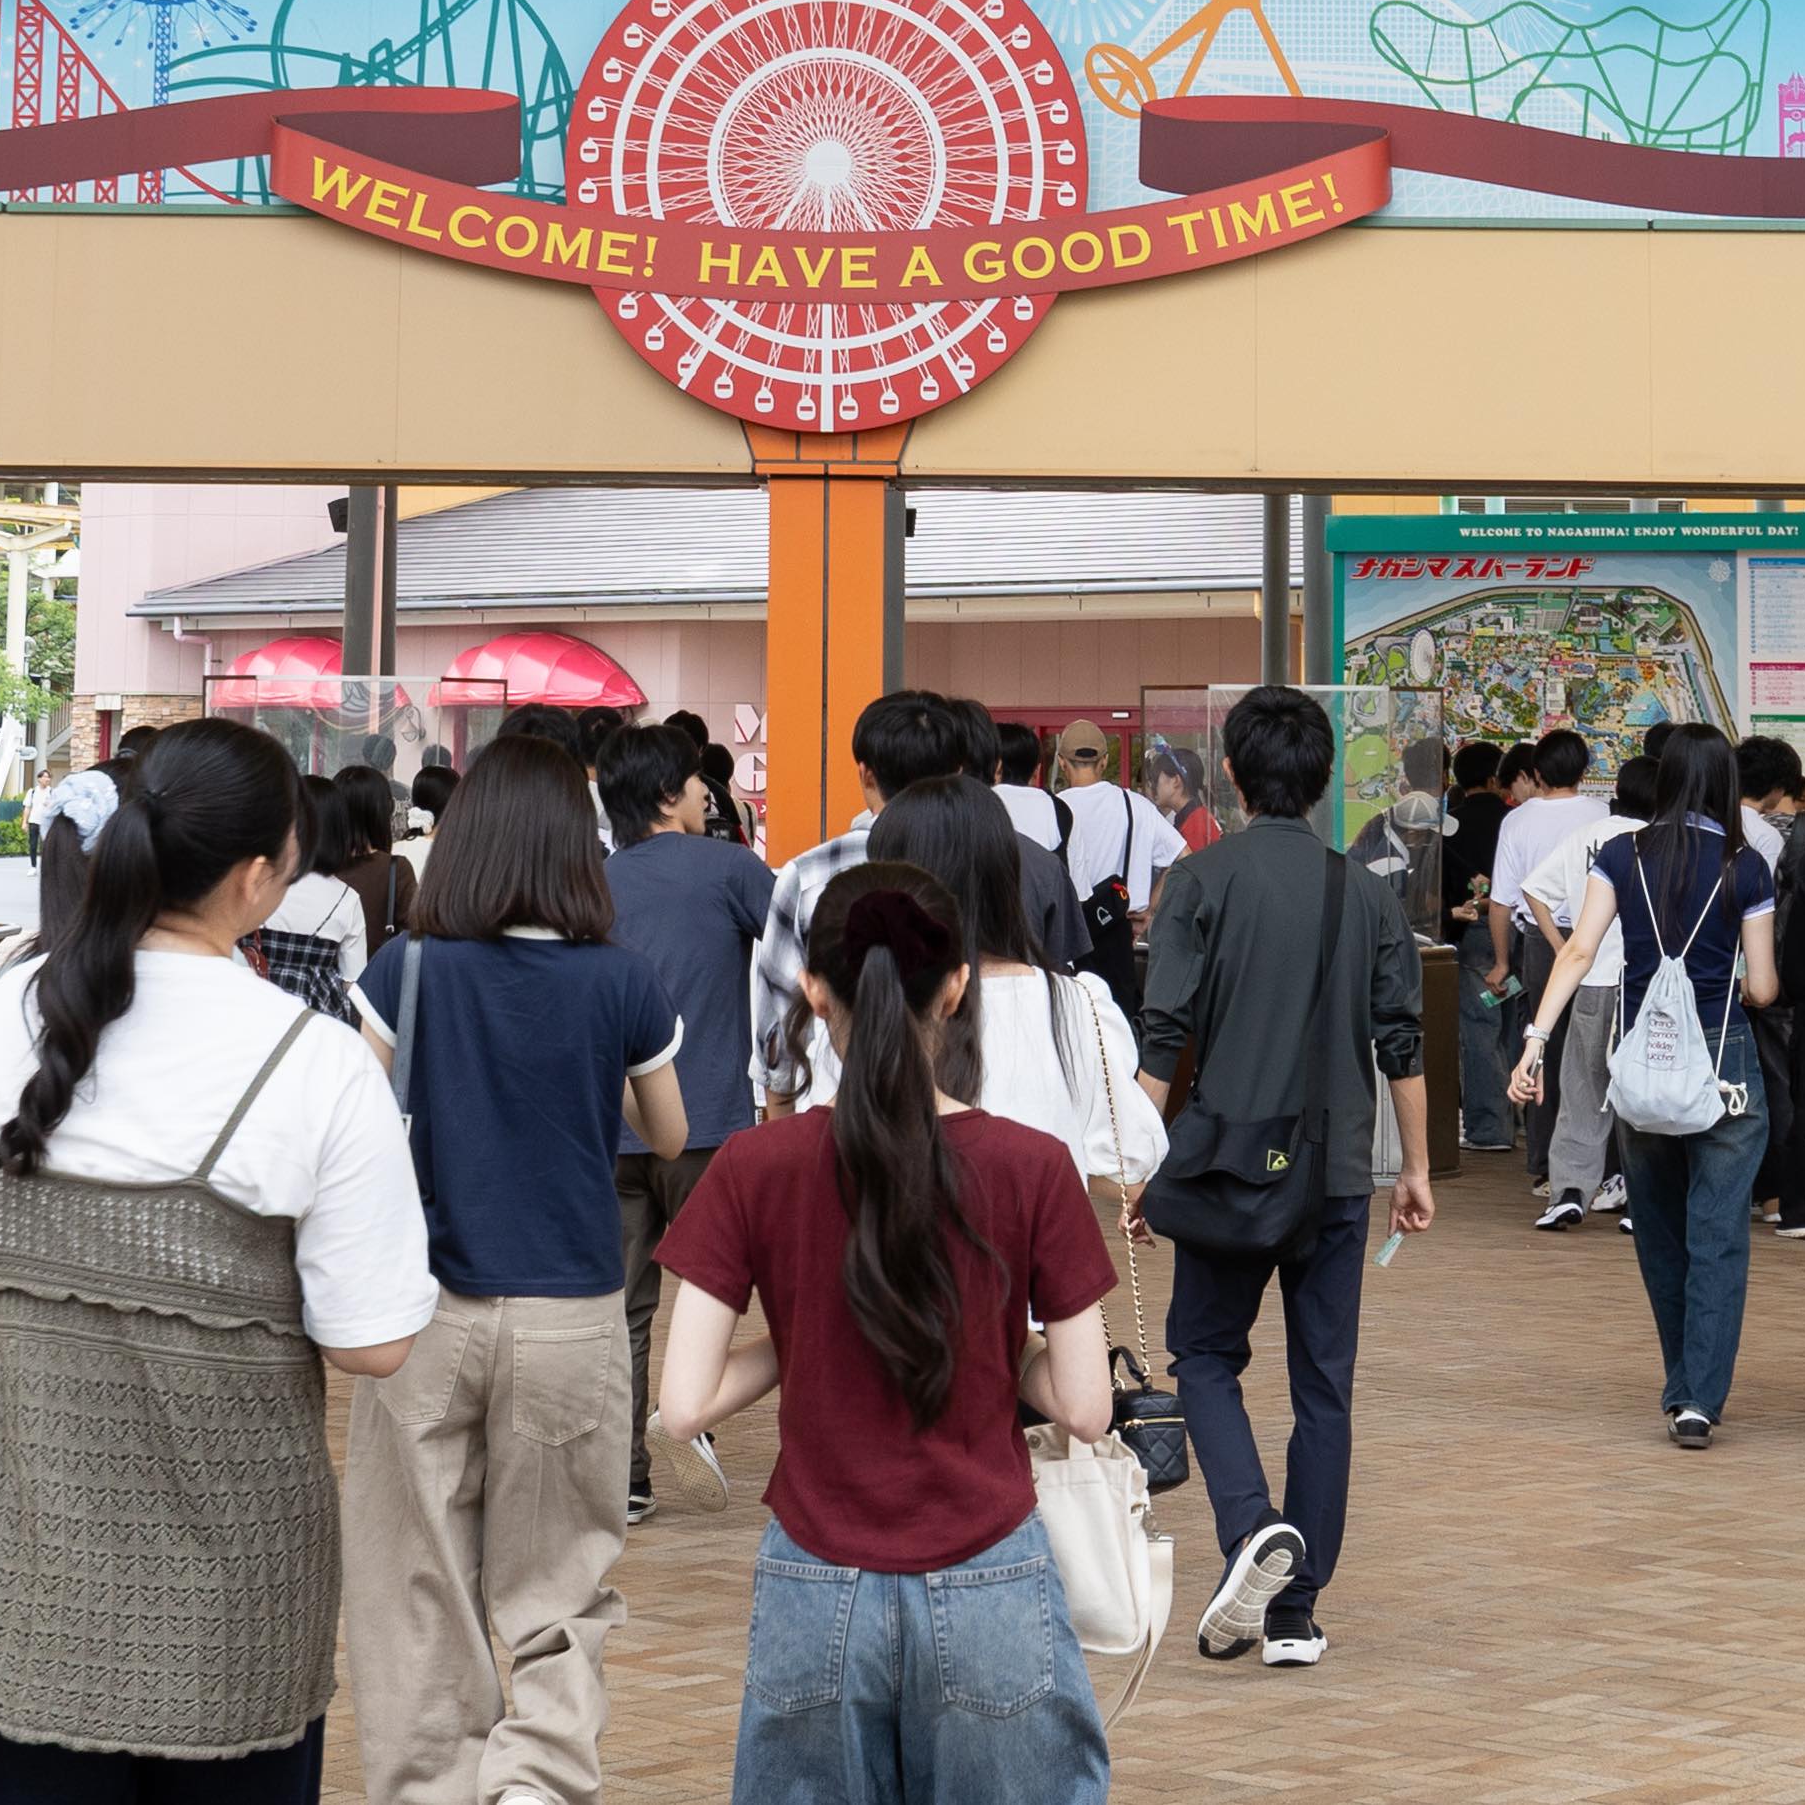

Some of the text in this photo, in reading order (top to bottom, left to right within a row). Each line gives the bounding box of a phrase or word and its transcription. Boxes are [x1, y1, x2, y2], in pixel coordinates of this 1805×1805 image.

[312, 157, 1343, 288] WELCOME! HAVE A GOOD TIME!
[1459, 526, 1799, 538] WELCOME TO NAGASHIMA! ENJOY WONDERFUL DAY!
